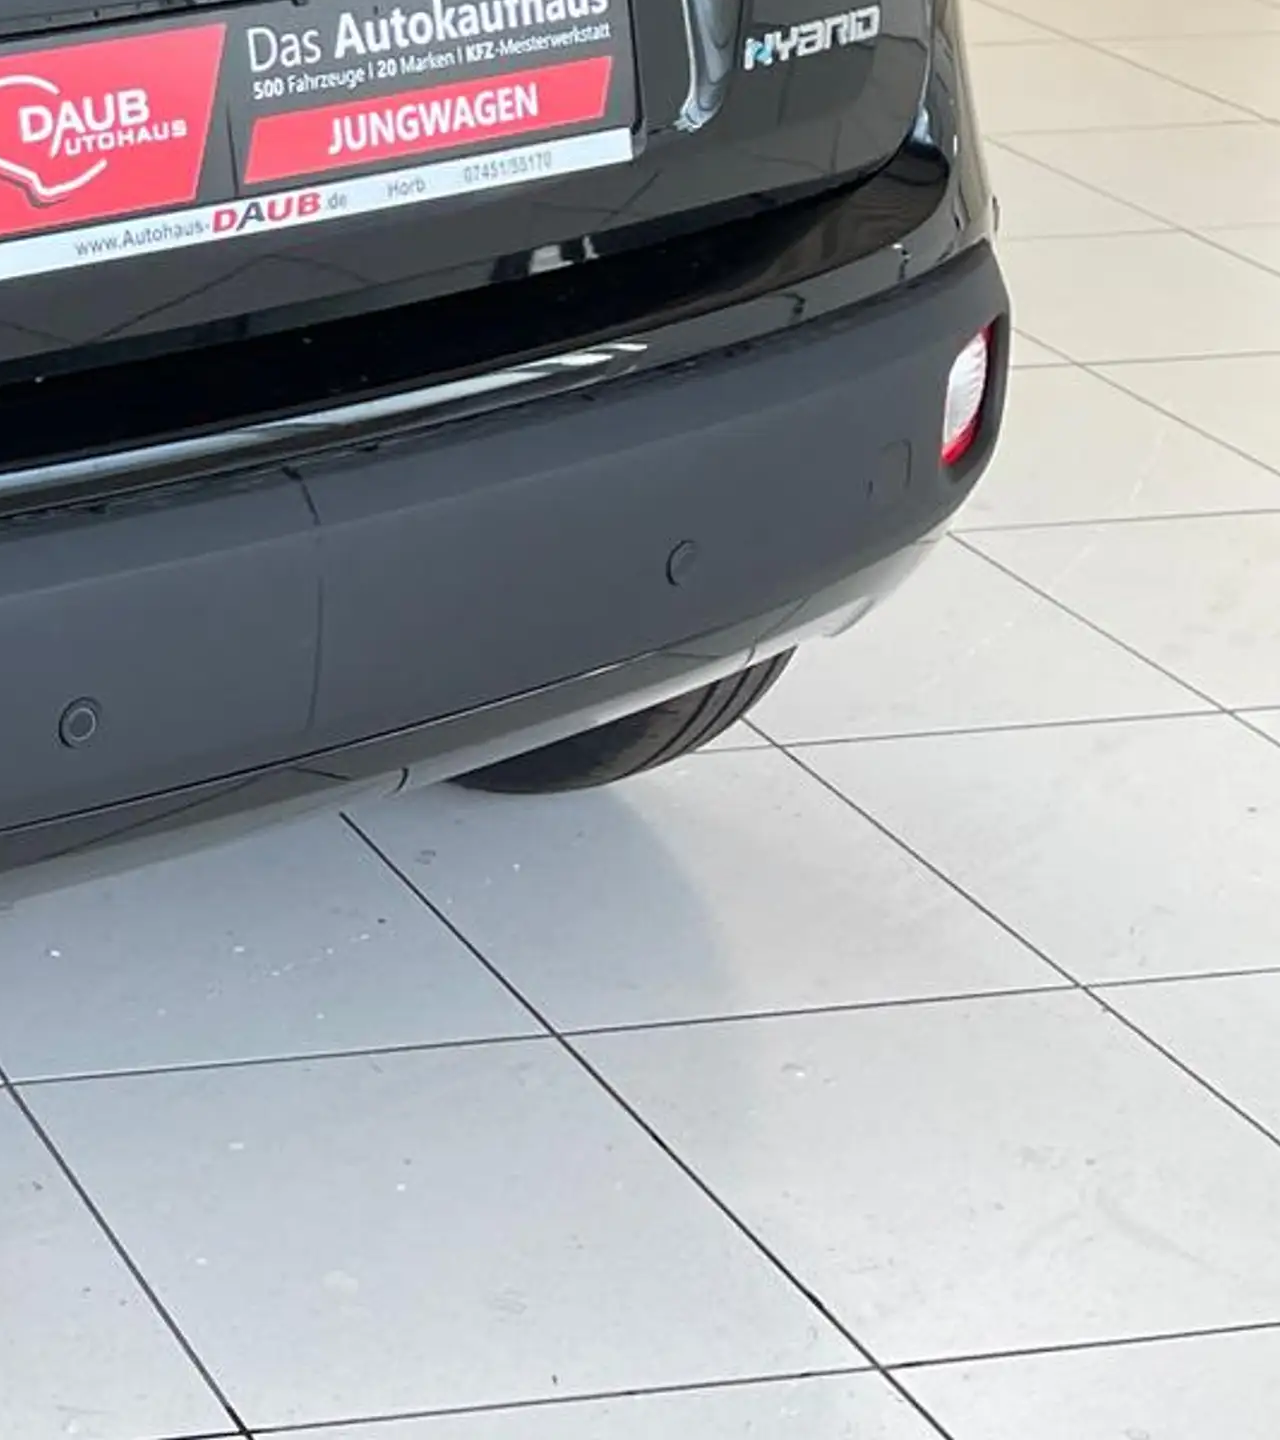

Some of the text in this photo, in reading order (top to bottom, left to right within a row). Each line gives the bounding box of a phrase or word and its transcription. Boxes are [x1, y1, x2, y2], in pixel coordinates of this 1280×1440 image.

[247, 27, 322, 73] Das
[253, 78, 285, 100] 500
[288, 68, 366, 94] Fahrzeuge
[377, 58, 398, 79] 20
[401, 49, 456, 75] Marken
[465, 21, 612, 64] KFZ-Meisterwerkstatt
[18, 88, 151, 158] DAUB
[328, 82, 539, 156] JUNGWAGEN
